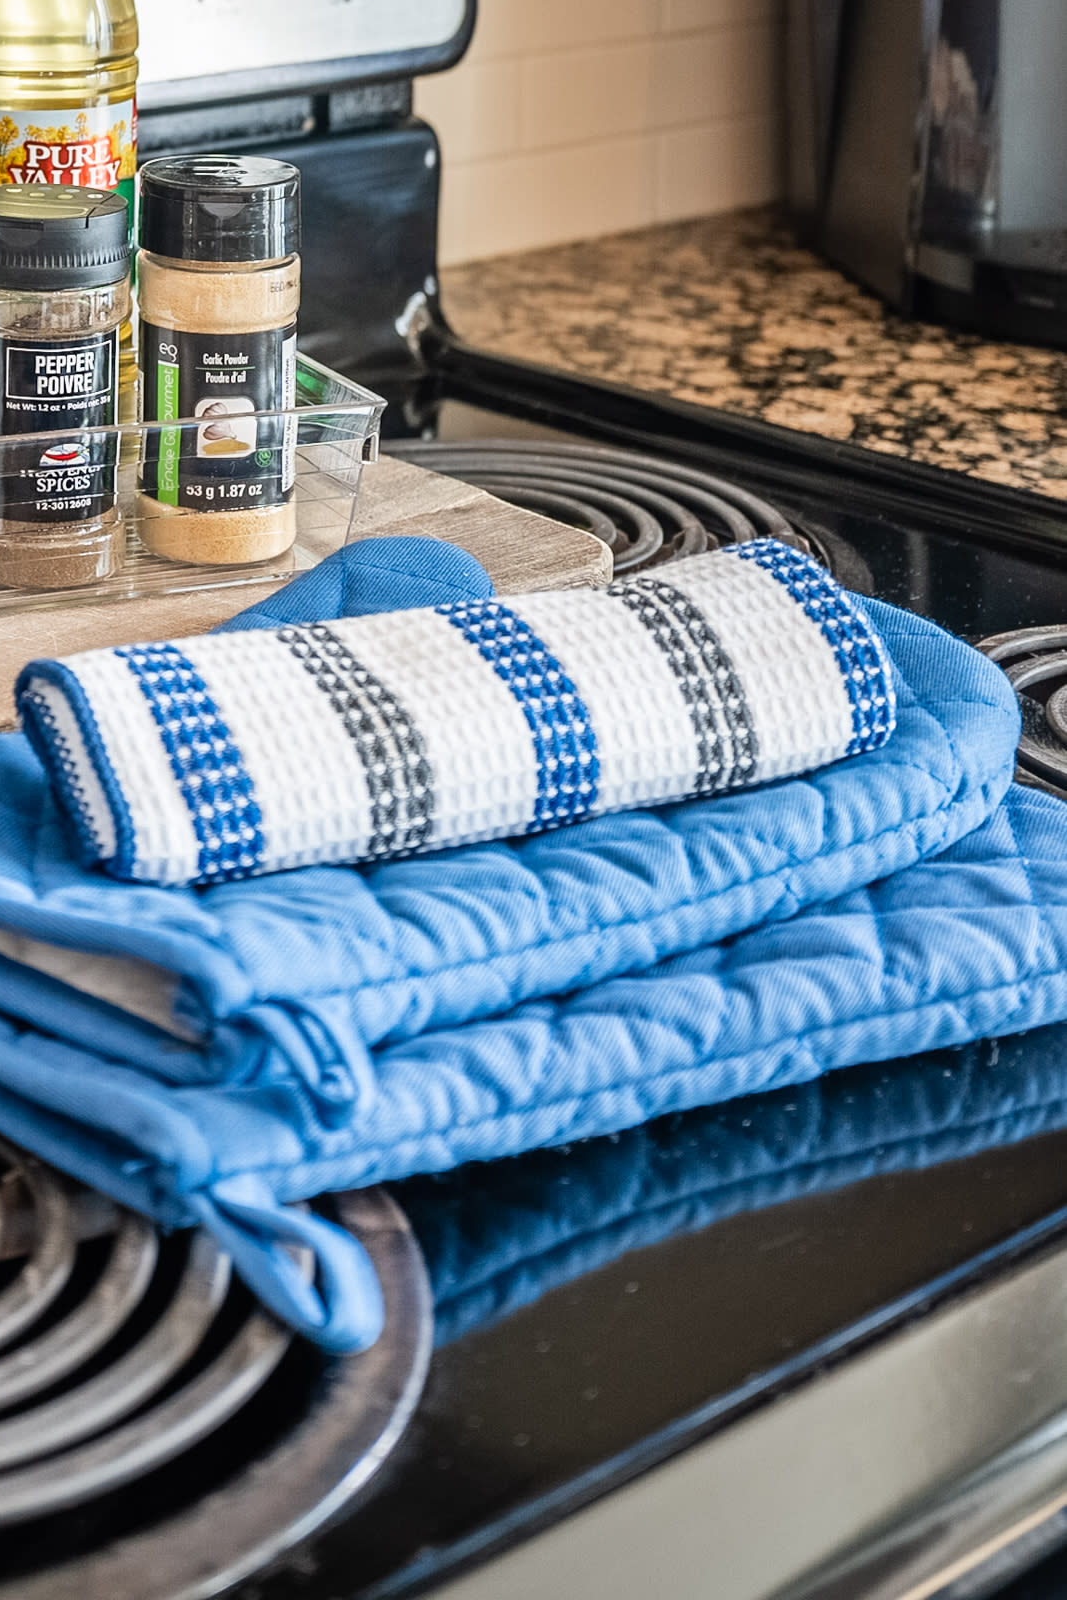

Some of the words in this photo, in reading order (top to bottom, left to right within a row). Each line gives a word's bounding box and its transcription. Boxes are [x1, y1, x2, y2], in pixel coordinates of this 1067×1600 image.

[26, 138, 112, 170] PURE
[10, 159, 122, 191] VALLEY
[35, 350, 95, 375] PEPPER
[202, 353, 223, 366] Garlic
[224, 352, 249, 366] Powder
[36, 371, 94, 396] POIVRE
[205, 371, 230, 384] Poudre
[5, 401, 21, 411] Net
[38, 403, 49, 412] 1.2
[50, 403, 61, 412] oz
[67, 401, 88, 411] Poids
[36, 474, 91, 492] SPICES
[186, 485, 203, 497] 53
[205, 487, 214, 500] g
[218, 484, 246, 498] 1.87
[248, 484, 263, 496] oz
[36, 498, 92, 510] 12-3012608
